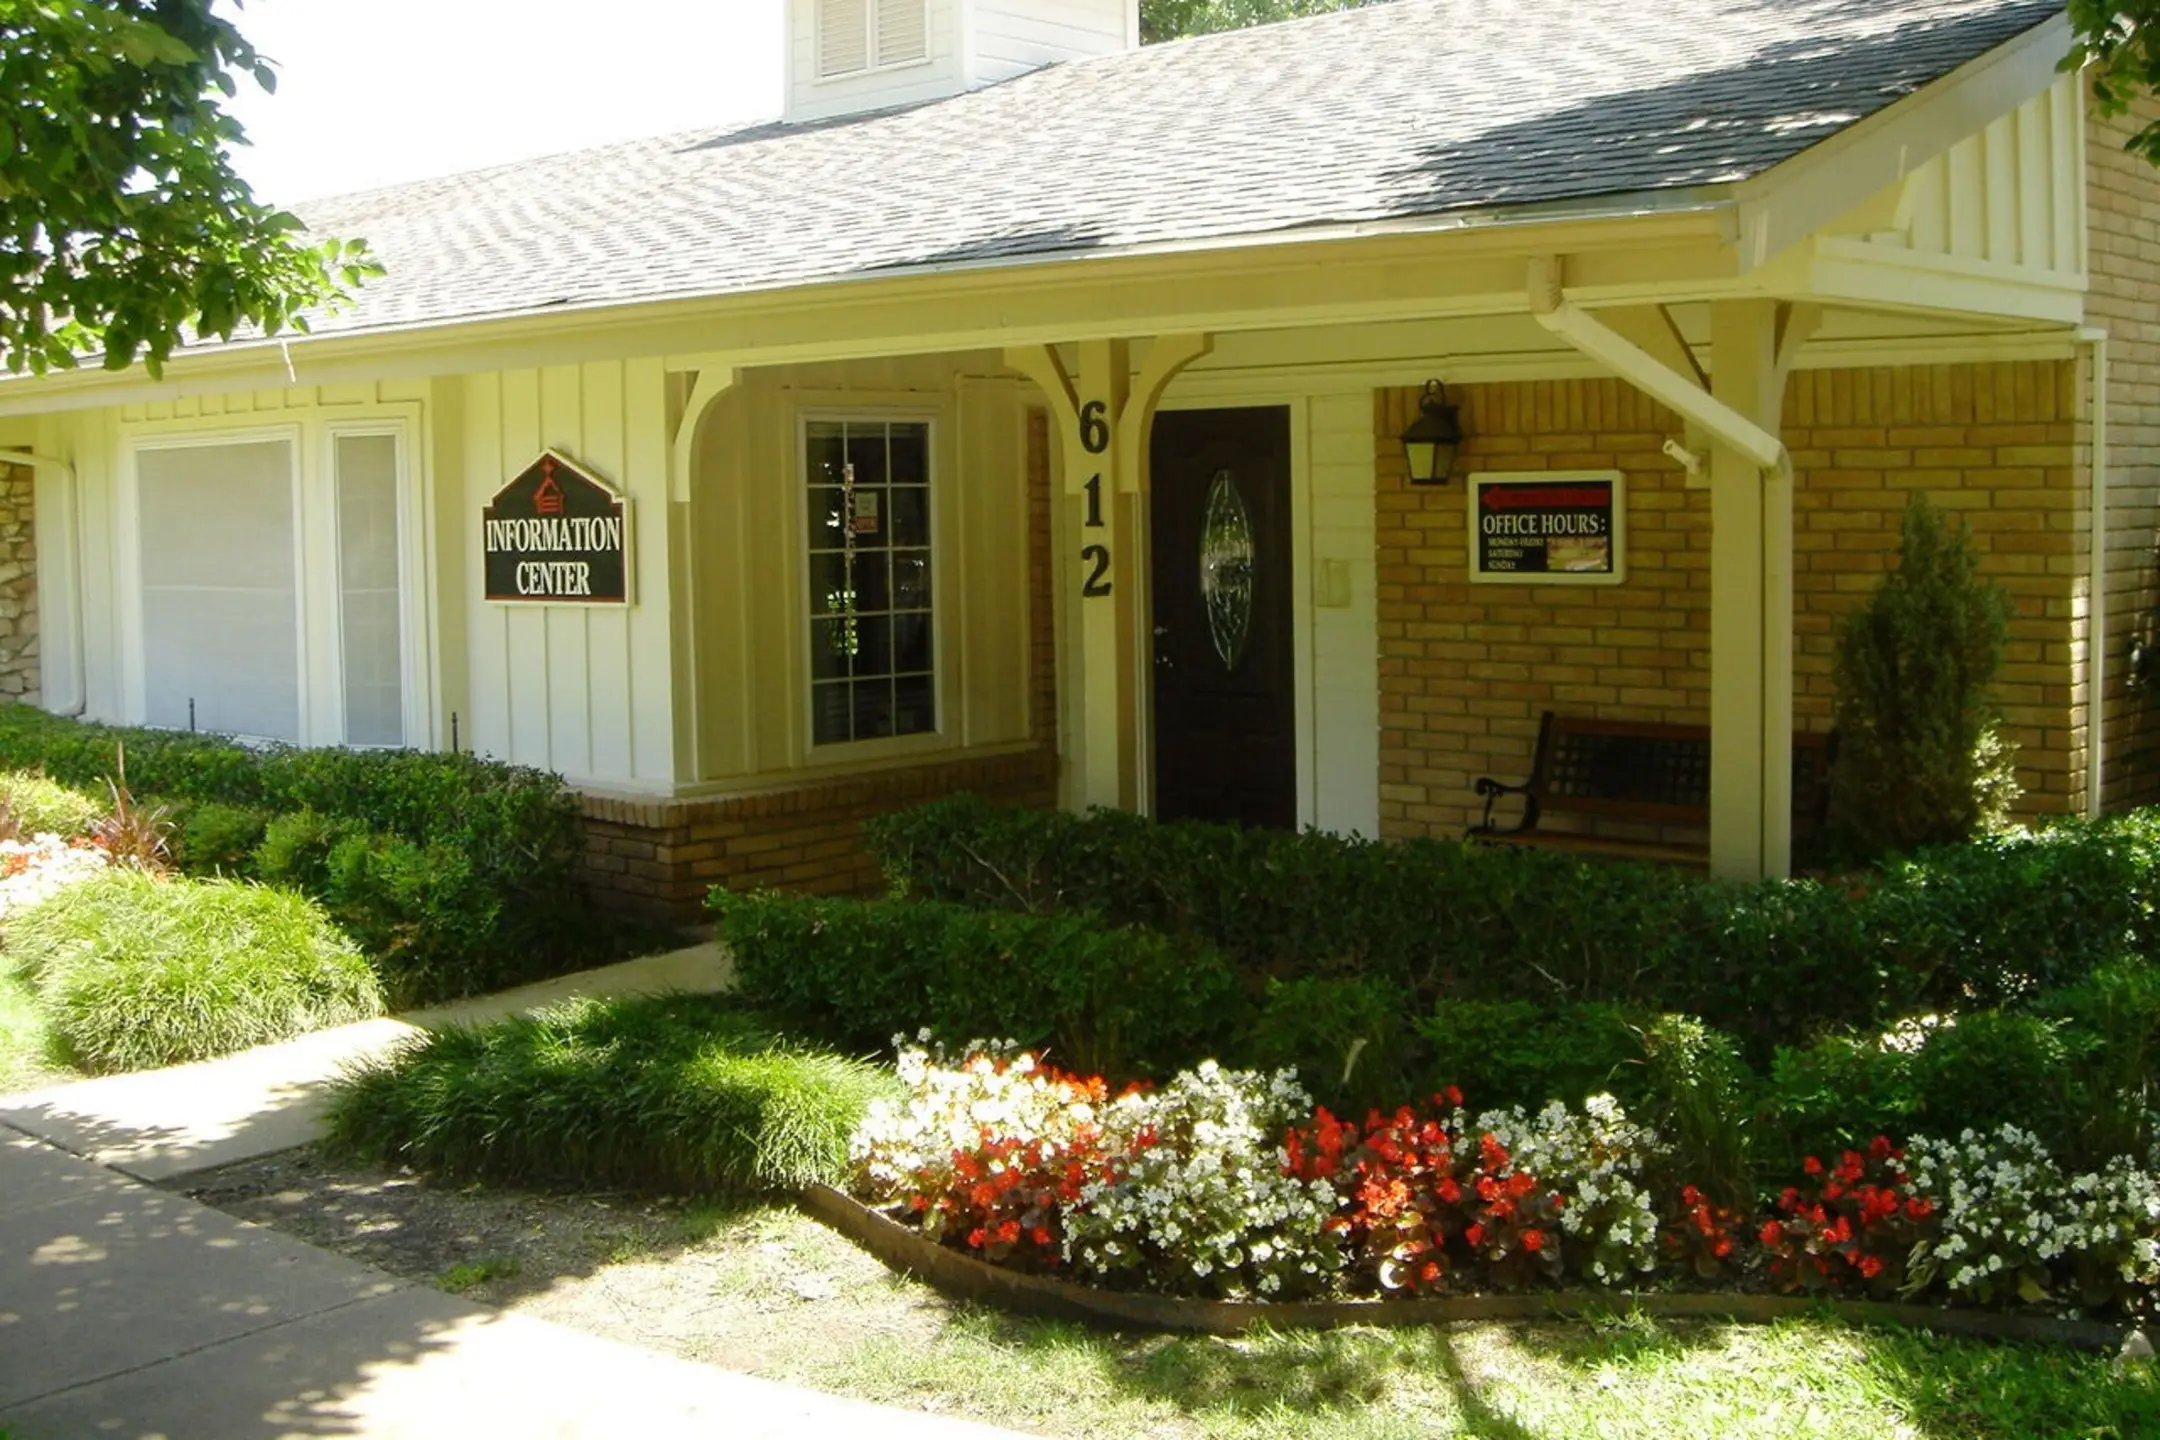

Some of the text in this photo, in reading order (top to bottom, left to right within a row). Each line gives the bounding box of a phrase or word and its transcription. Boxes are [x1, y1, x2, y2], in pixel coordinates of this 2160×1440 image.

[1080, 400, 1112, 598] 612
[486, 516, 620, 552] INFORMATION
[1483, 514, 1606, 534] OFFICE HOURS:
[516, 561, 591, 595] CENTER
